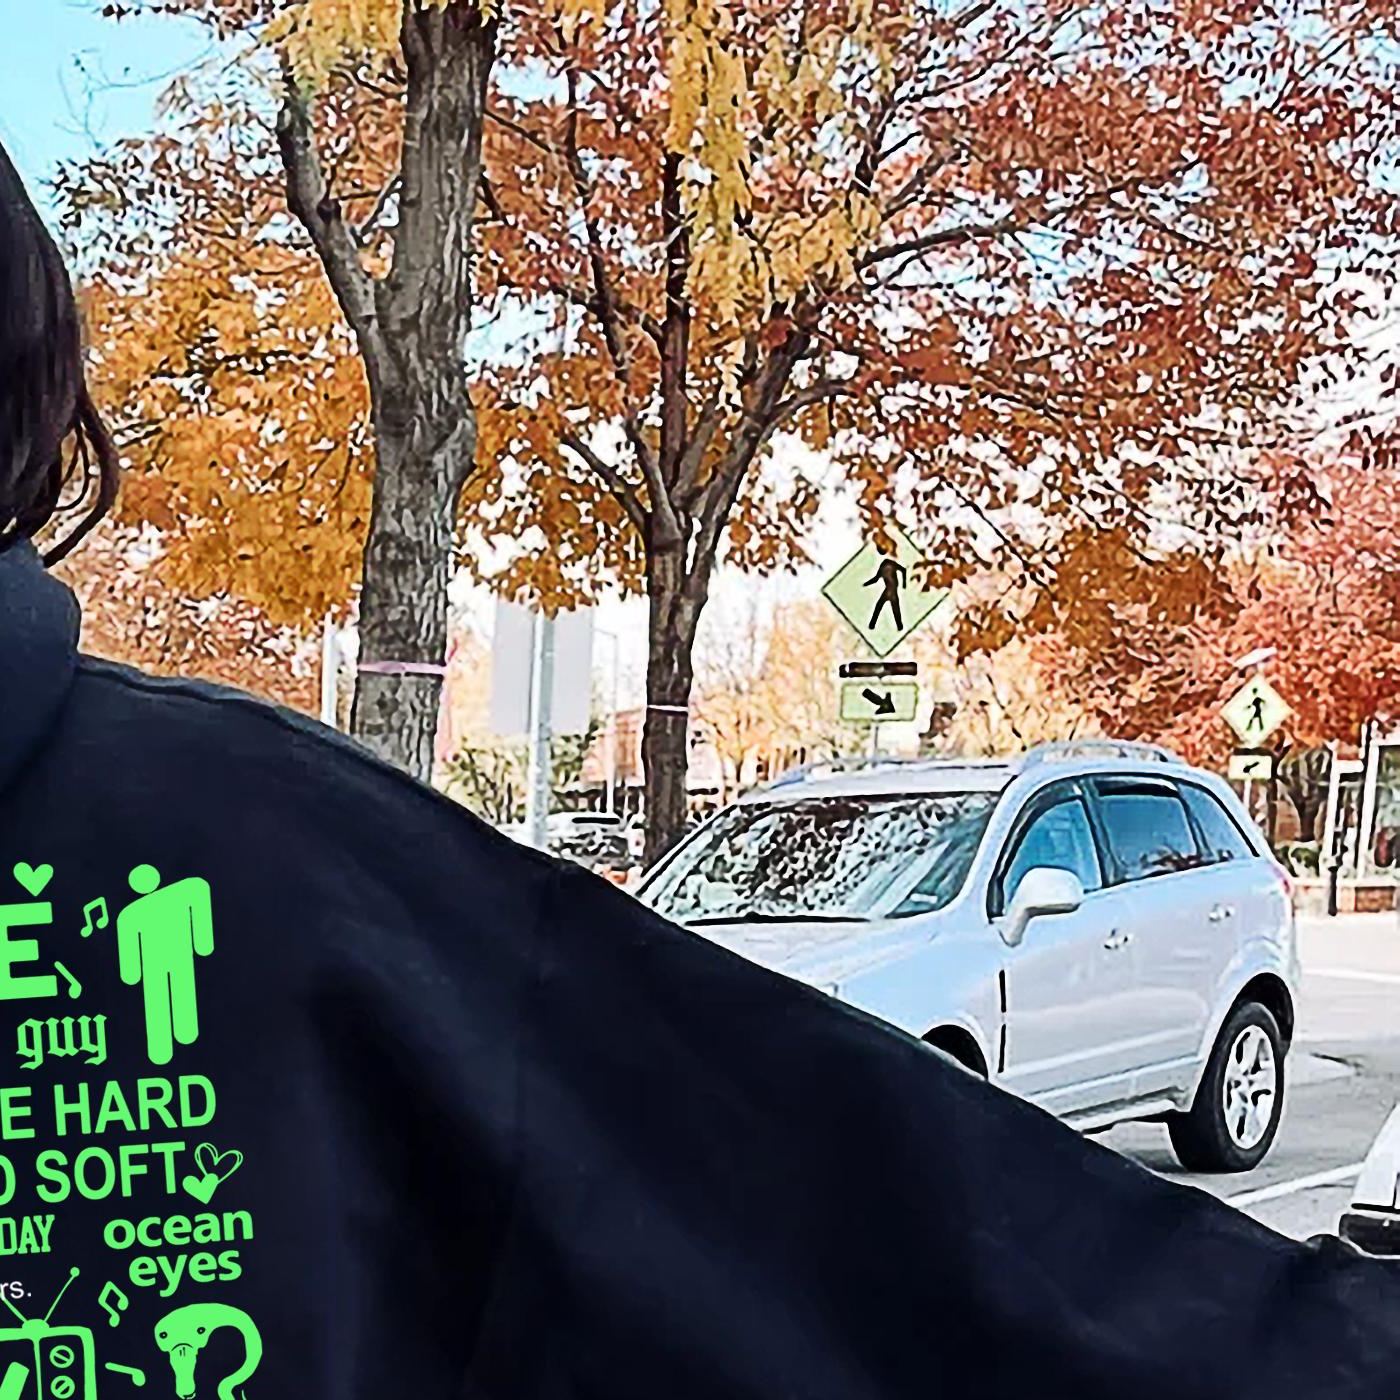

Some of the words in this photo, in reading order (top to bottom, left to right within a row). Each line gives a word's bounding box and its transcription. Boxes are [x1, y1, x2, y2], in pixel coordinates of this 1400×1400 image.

[16, 1013, 108, 1071] guy
[53, 1074, 218, 1138] HARD
[35, 1141, 186, 1204] SOFT
[103, 1210, 255, 1251] ocean
[128, 1249, 243, 1298] eyes
